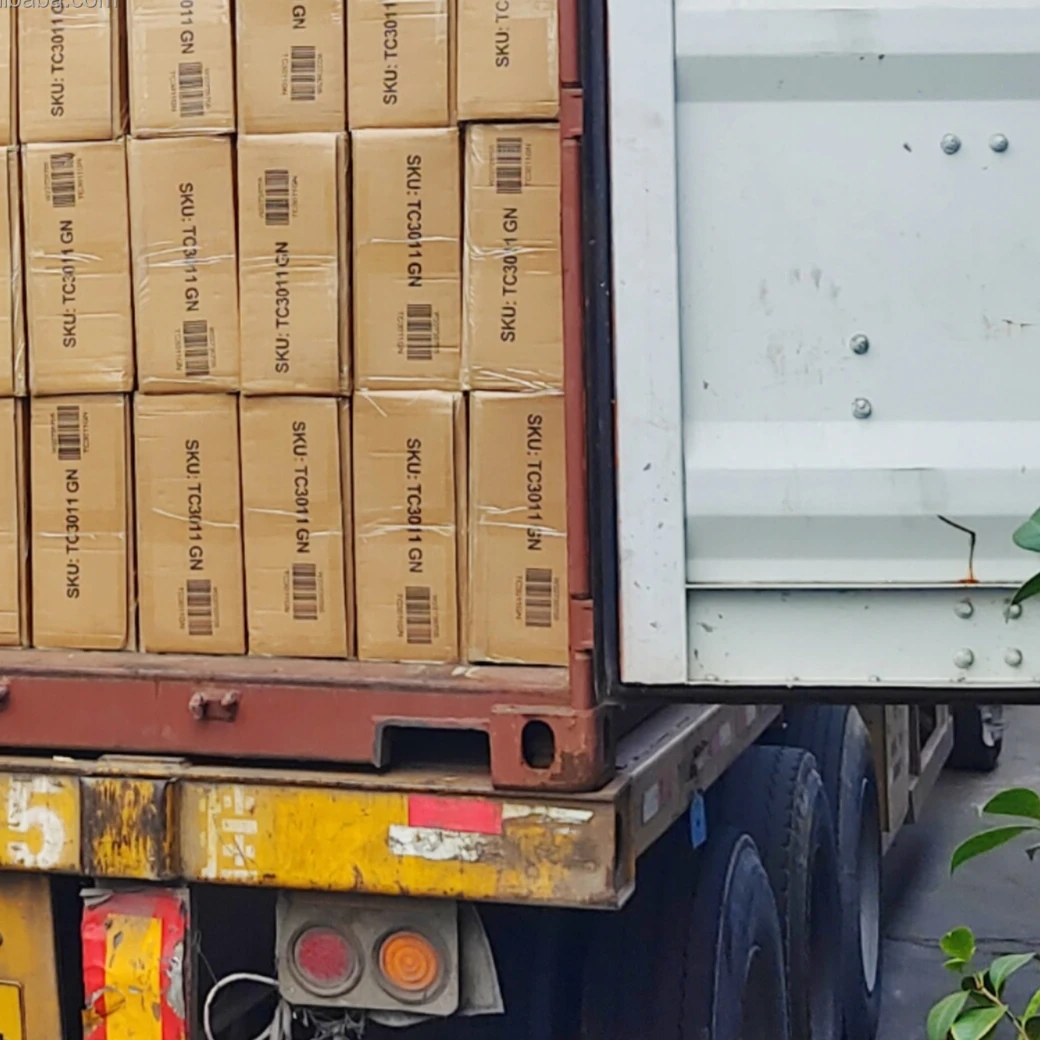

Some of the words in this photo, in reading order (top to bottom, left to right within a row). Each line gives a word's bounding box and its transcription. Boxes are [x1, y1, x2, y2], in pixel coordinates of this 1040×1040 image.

[291, 4, 307, 30] GN
[383, 2, 398, 61] TC3011
[179, 29, 195, 55] GN
[495, 25, 510, 68] SKU:
[382, 63, 398, 105] SKU:
[406, 154, 422, 196] SKU:
[59, 219, 74, 245] GN
[406, 199, 423, 258] TC3011
[274, 241, 290, 268] GN
[407, 261, 424, 288] GN
[59, 248, 76, 305] TC3011
[274, 271, 290, 329] TC3011
[61, 307, 77, 348] SKU:
[274, 332, 290, 374] SKU:
[291, 420, 308, 462] SKU:
[526, 413, 543, 456] SKU:
[406, 438, 422, 480] SKU:
[65, 468, 80, 494] GN
[293, 465, 310, 524] TC3011
[526, 460, 543, 520] TC3011
[65, 498, 80, 555] TC3011
[406, 483, 423, 543] TC3011
[295, 527, 311, 554] GN
[408, 547, 423, 573] GN
[526, 527, 543, 551] GN
[66, 557, 80, 599] SKU:
